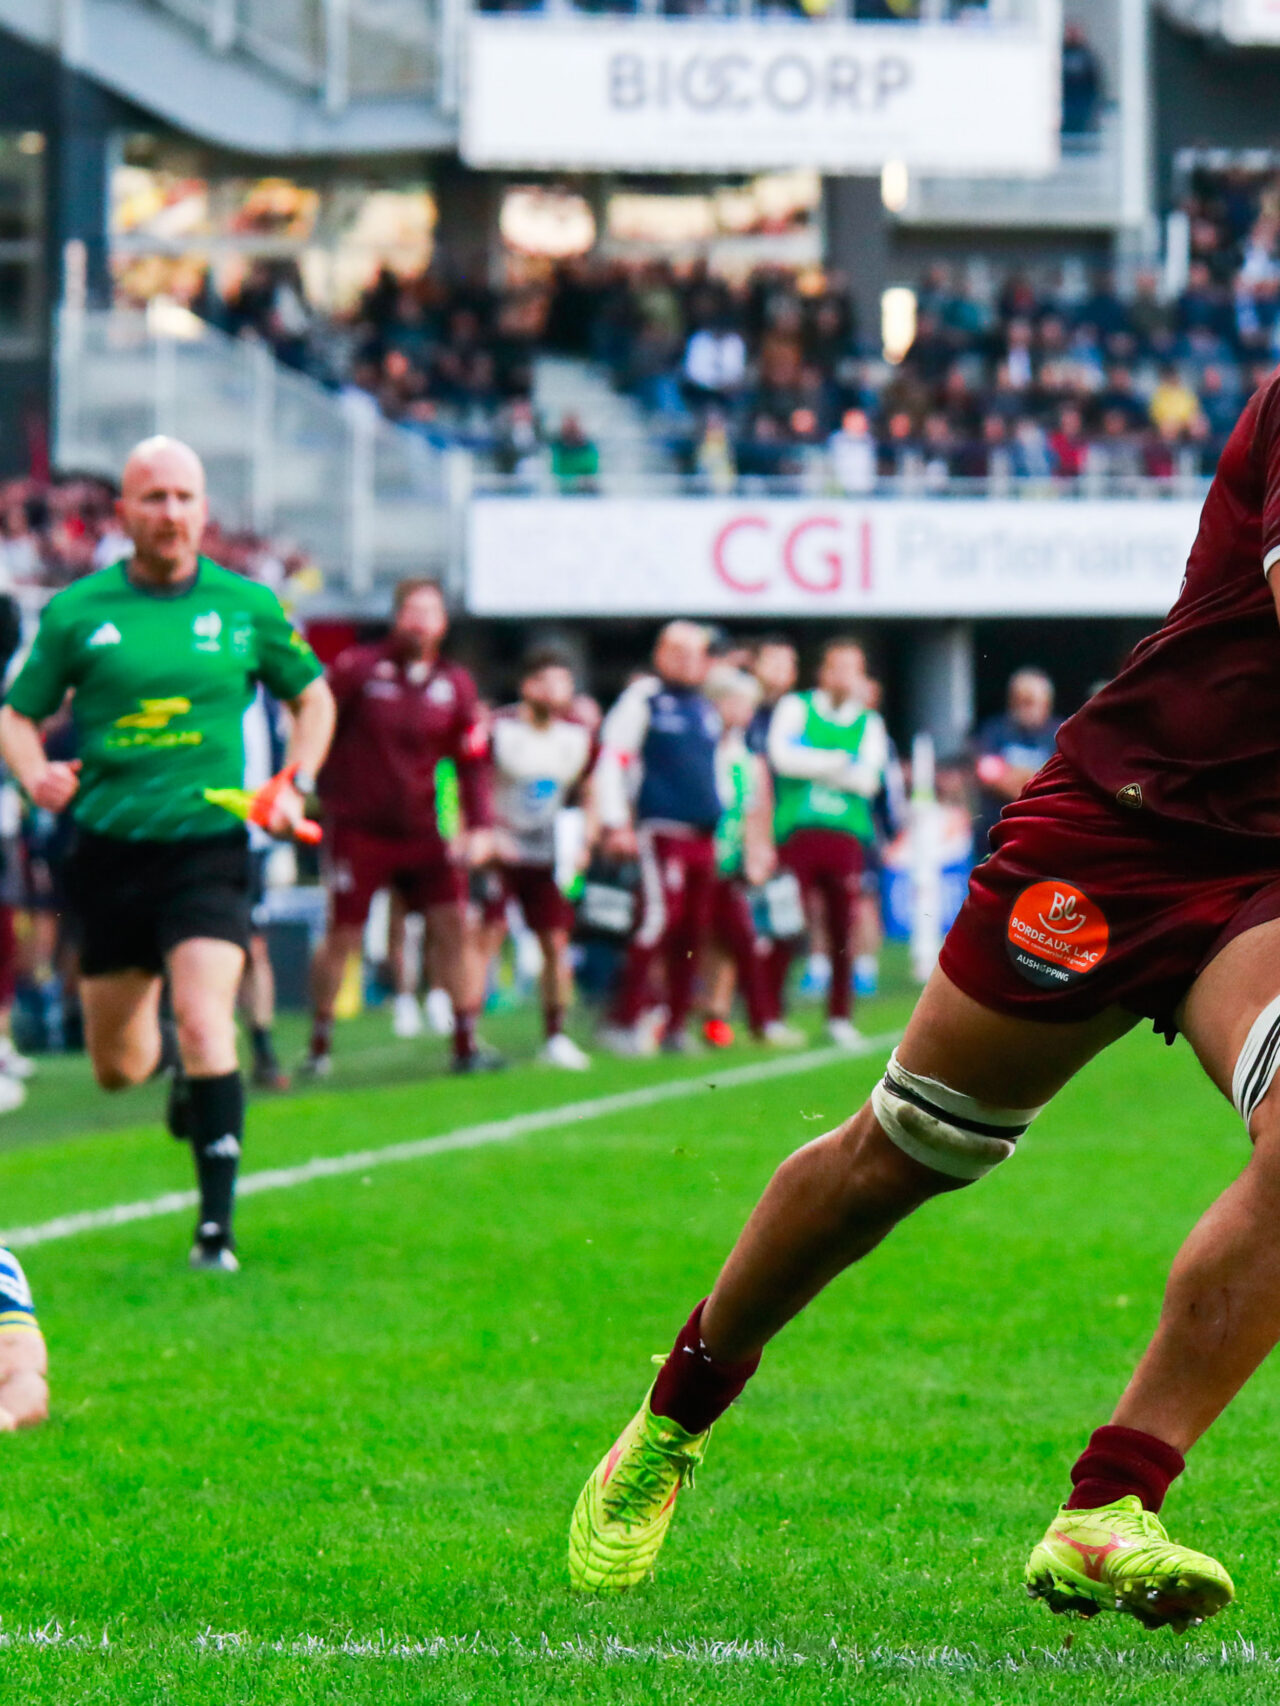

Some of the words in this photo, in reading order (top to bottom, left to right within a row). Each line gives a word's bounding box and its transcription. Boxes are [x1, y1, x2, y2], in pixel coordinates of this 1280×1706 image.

[712, 515, 873, 594] CGI
[1012, 917, 1072, 954] BORDEAUX
[1074, 946, 1099, 963] LAC
[1016, 954, 1070, 982] AUSHOPPING
